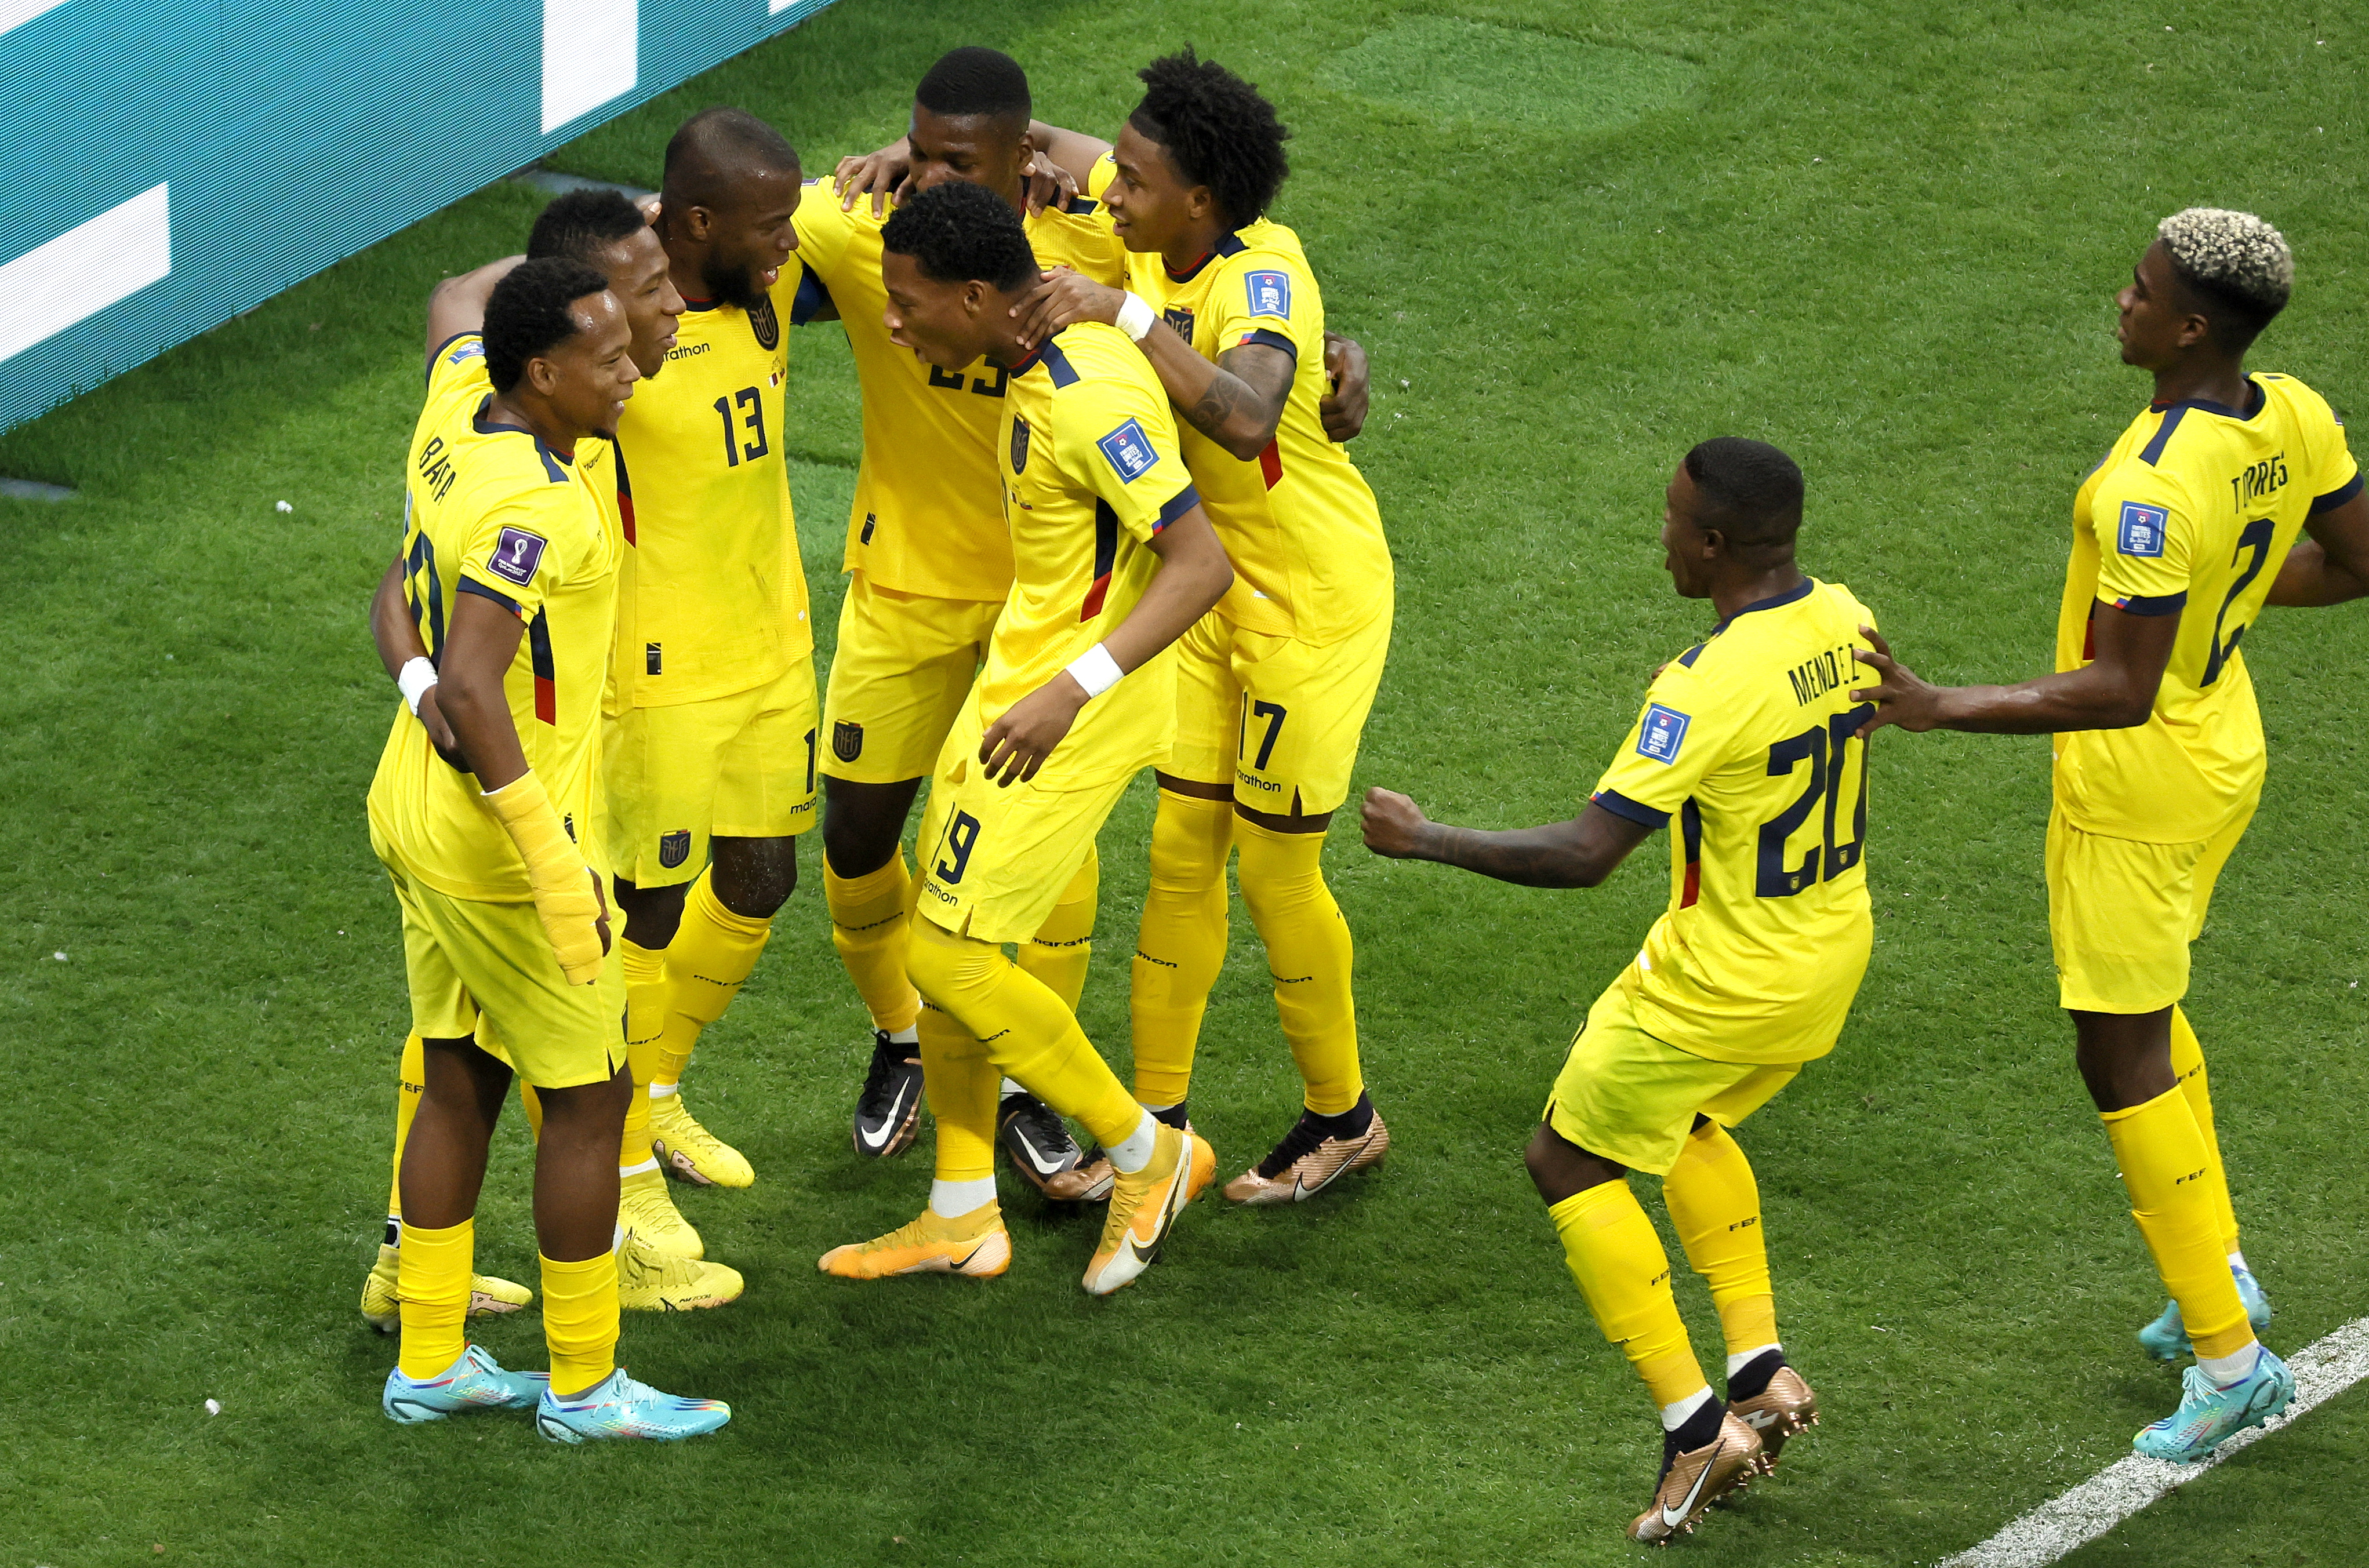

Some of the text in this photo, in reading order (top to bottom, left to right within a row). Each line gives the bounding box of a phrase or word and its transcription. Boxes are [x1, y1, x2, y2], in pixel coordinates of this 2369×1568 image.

[713, 386, 768, 467] 13
[2199, 518, 2276, 688] 2
[1239, 692, 1287, 770] 17
[1756, 702, 1876, 897] 20
[931, 801, 980, 884] 19
[2177, 1167, 2207, 1185] FEF
